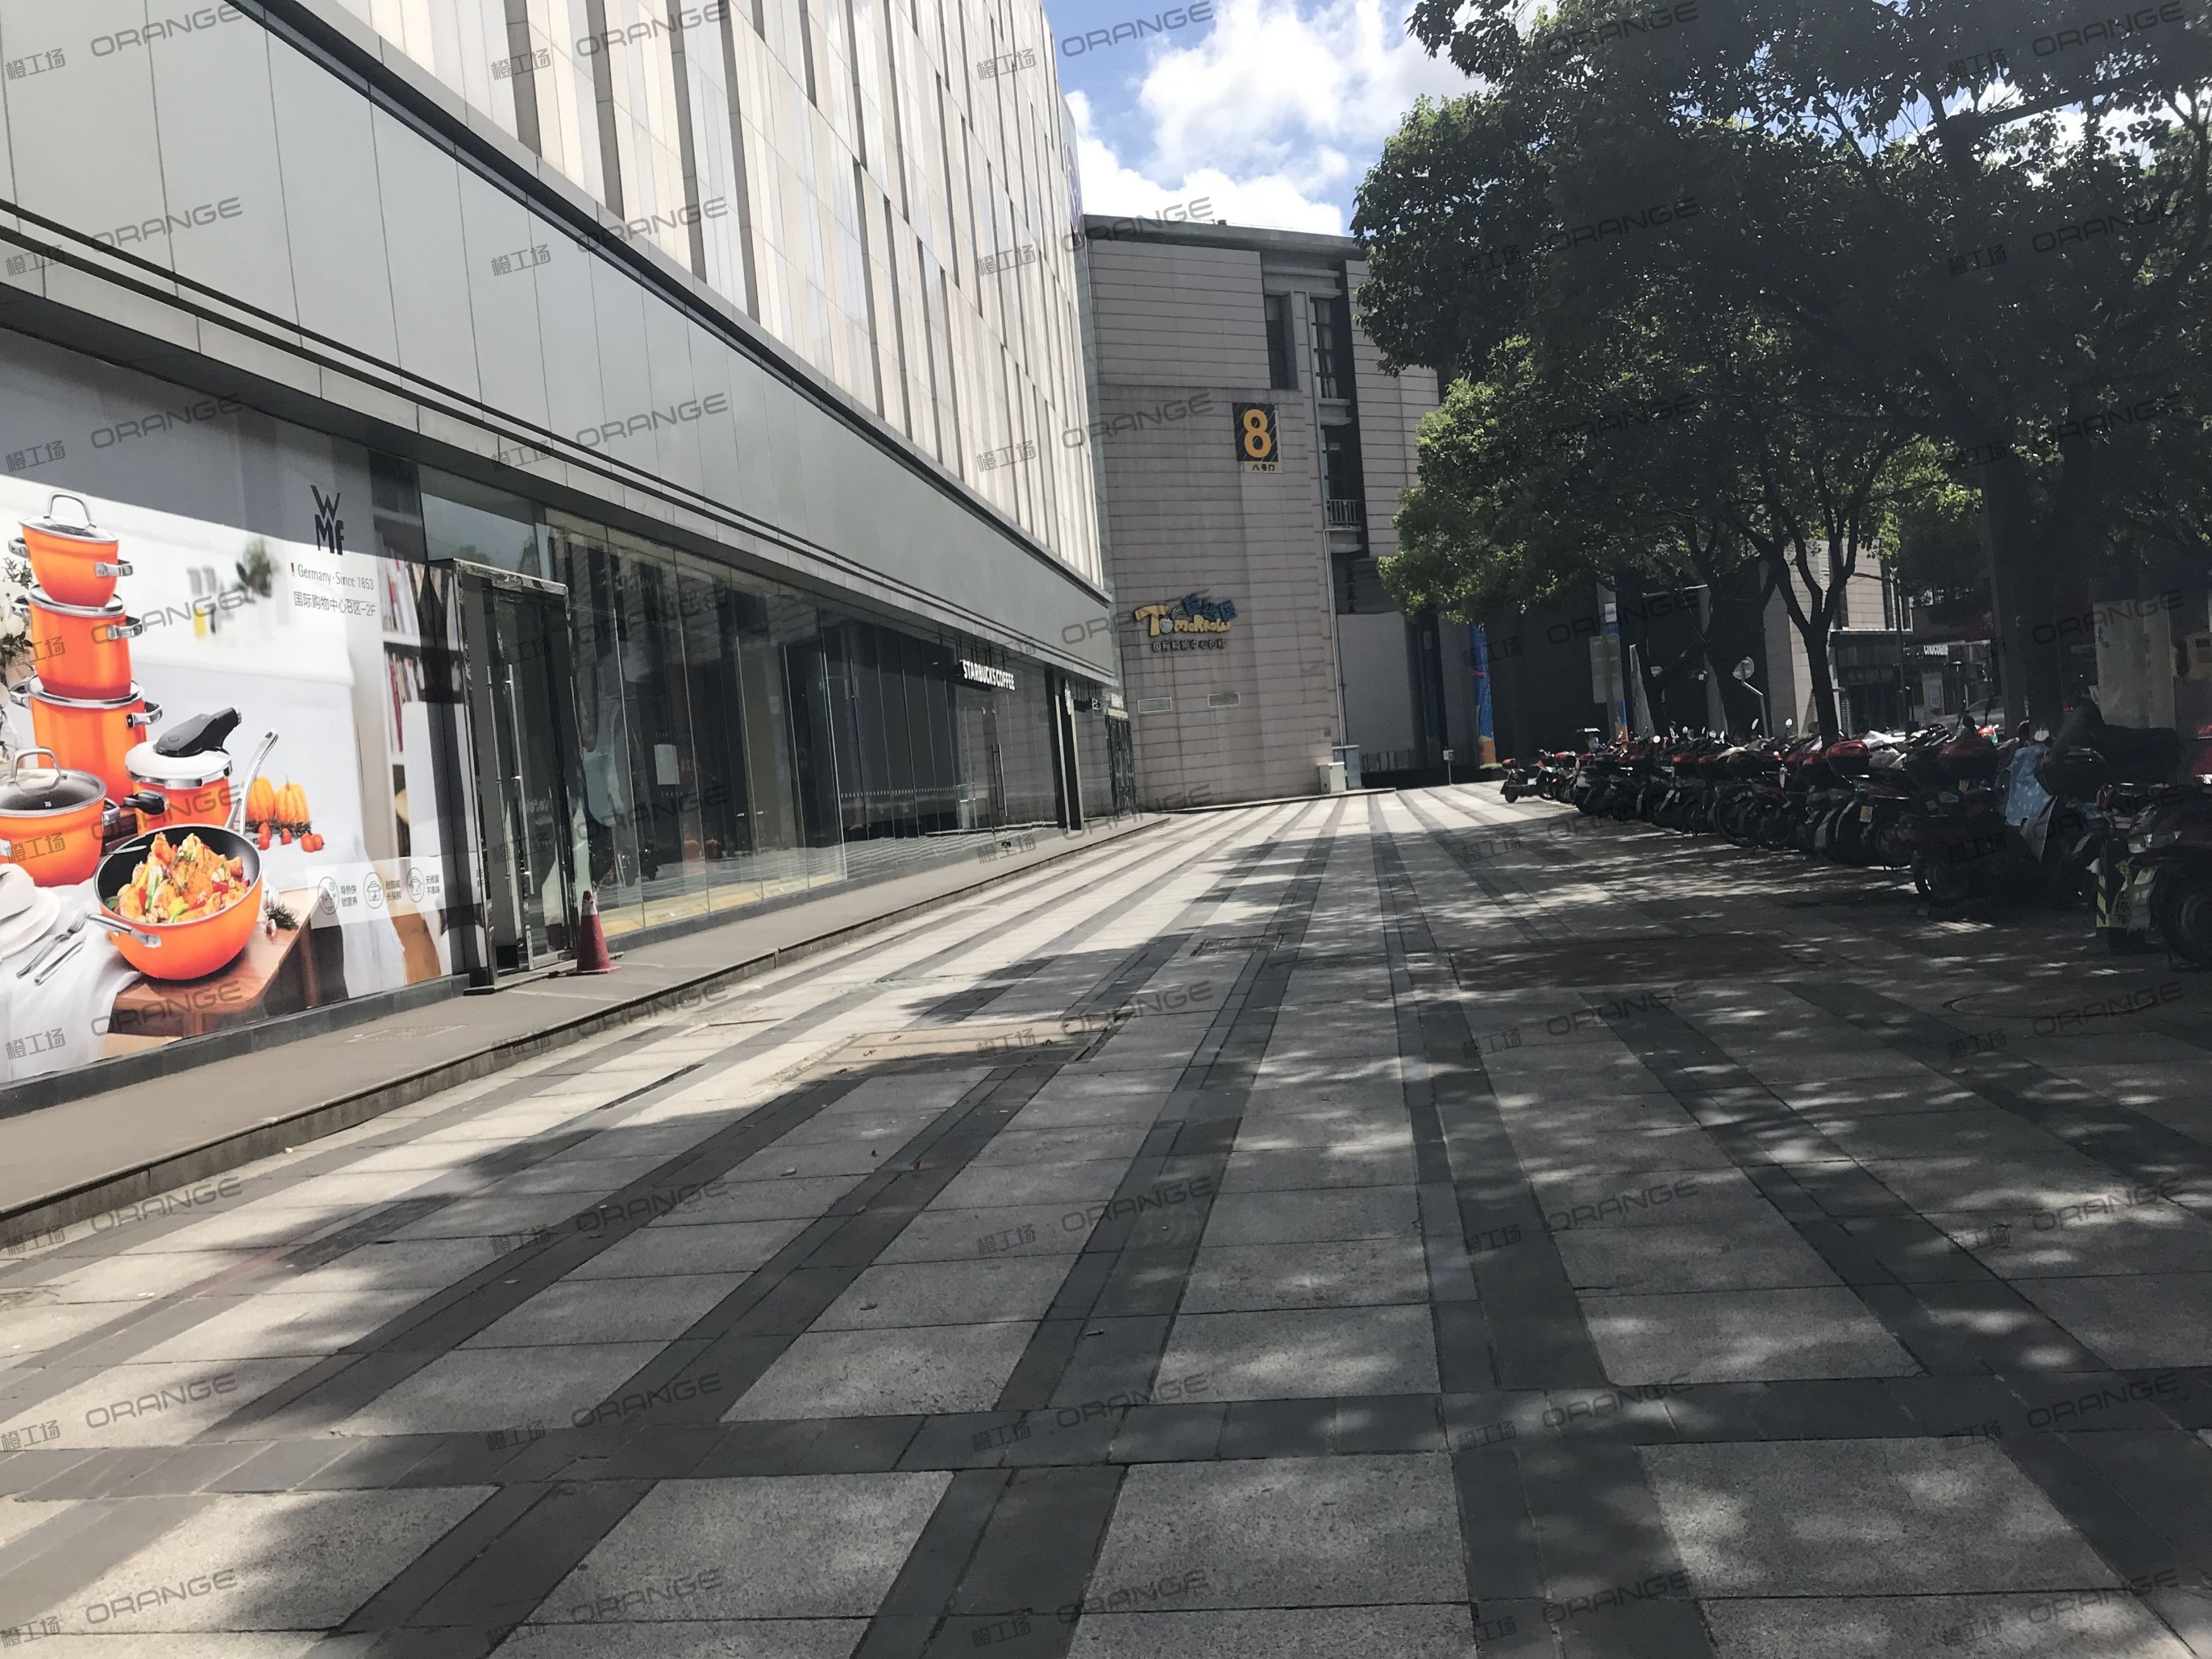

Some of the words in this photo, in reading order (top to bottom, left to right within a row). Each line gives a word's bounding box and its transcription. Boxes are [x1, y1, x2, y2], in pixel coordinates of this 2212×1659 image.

[1243, 408, 1272, 458] 8
[1252, 463, 1275, 471] 八号门
[310, 485, 344, 556] WMF
[357, 576, 374, 590] 1853
[963, 659, 996, 686] STARBUCKS
[995, 669, 1015, 691] COFFEE
[340, 885, 357, 895] 导热快
